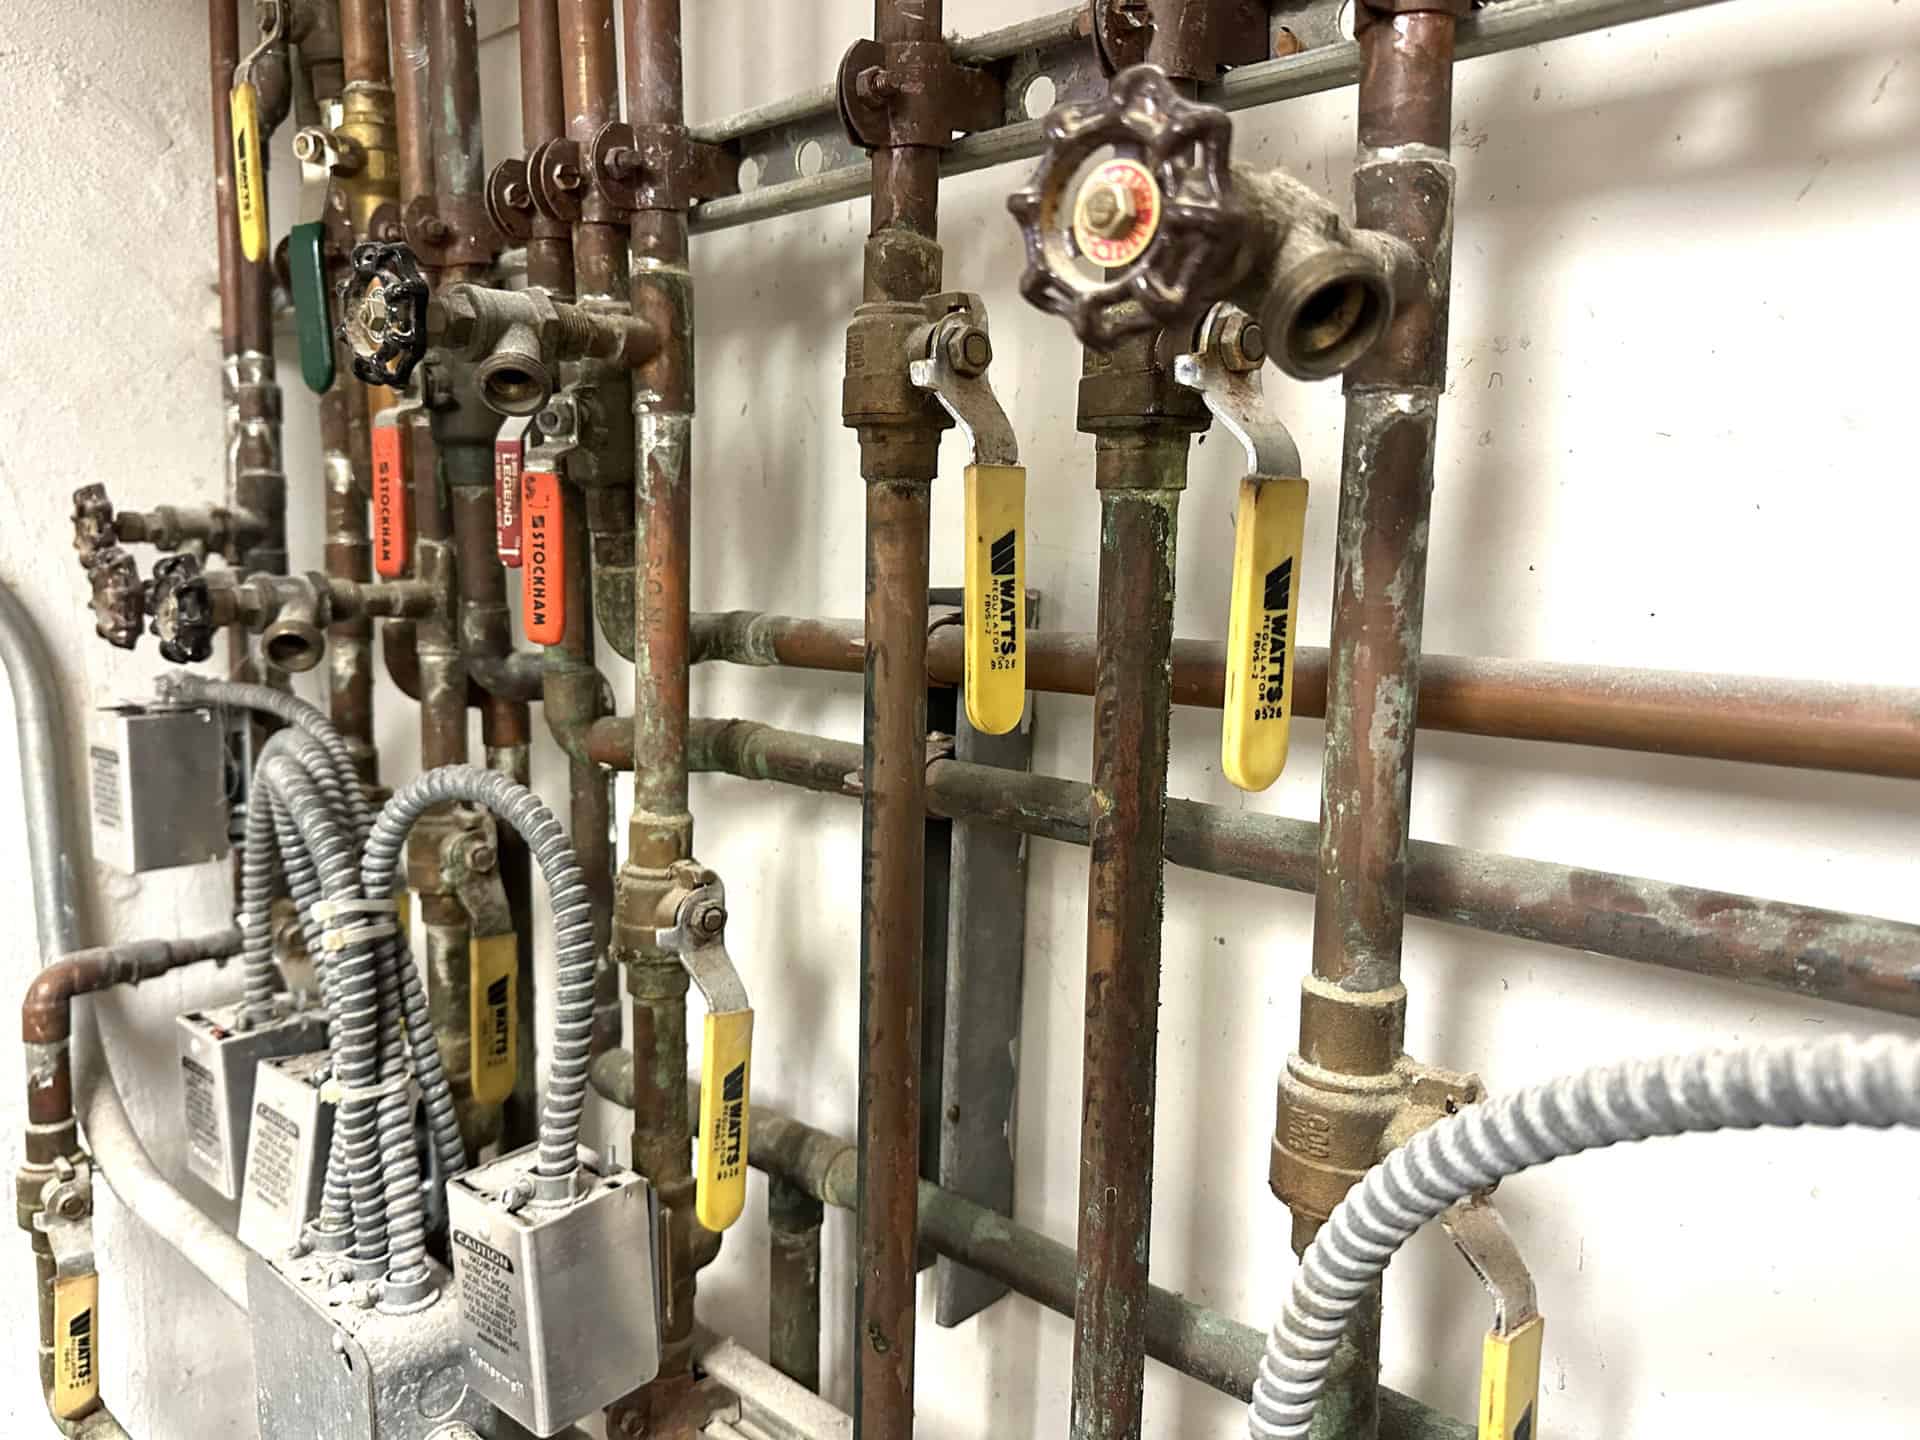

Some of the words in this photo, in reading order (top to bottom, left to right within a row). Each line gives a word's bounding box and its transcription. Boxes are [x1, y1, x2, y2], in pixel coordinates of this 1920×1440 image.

[380, 477, 391, 561] STOCKHAM
[502, 453, 513, 527] LEGEND
[532, 532, 547, 626] STOCKHAM
[992, 579, 1000, 654] REGULATOR
[1000, 578, 1016, 656] WATTS
[1258, 615, 1271, 701] REGULATOR
[1266, 613, 1288, 703] WATTS
[496, 1005, 509, 1055] WATTS
[726, 1101, 743, 1166] WATTS
[456, 1231, 511, 1270] CAUTION
[78, 1334, 91, 1378] WATTS
